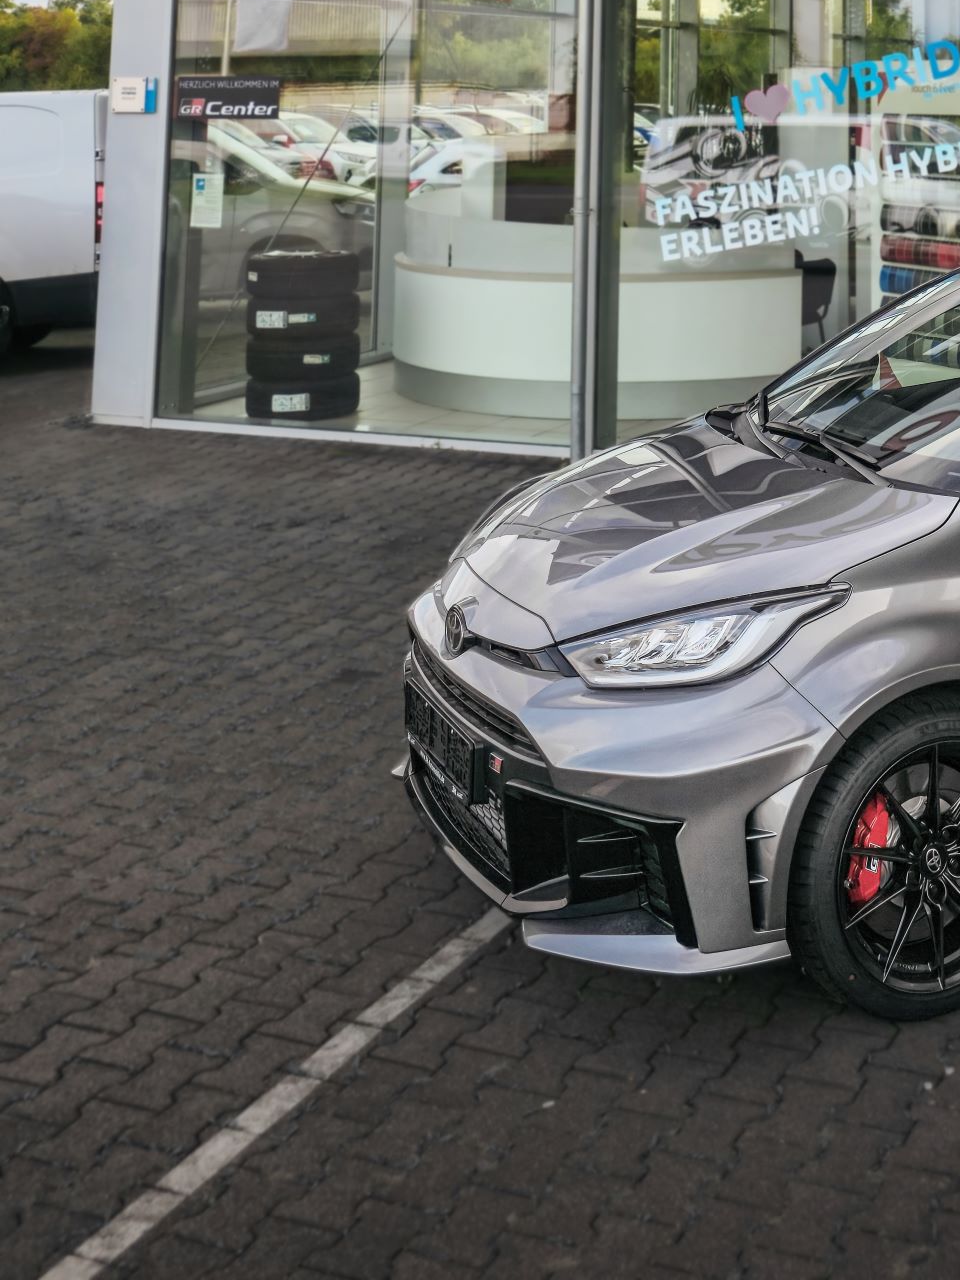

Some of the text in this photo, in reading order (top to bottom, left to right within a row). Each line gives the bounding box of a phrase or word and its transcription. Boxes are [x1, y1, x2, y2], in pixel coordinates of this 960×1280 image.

[180, 80, 279, 89] HERZLICH WILLKOMMEN IM
[792, 39, 960, 116] HYBRID
[180, 101, 278, 116] GR Center
[655, 161, 877, 226] FASZINATION
[660, 206, 820, 262] ERLEBEN!
